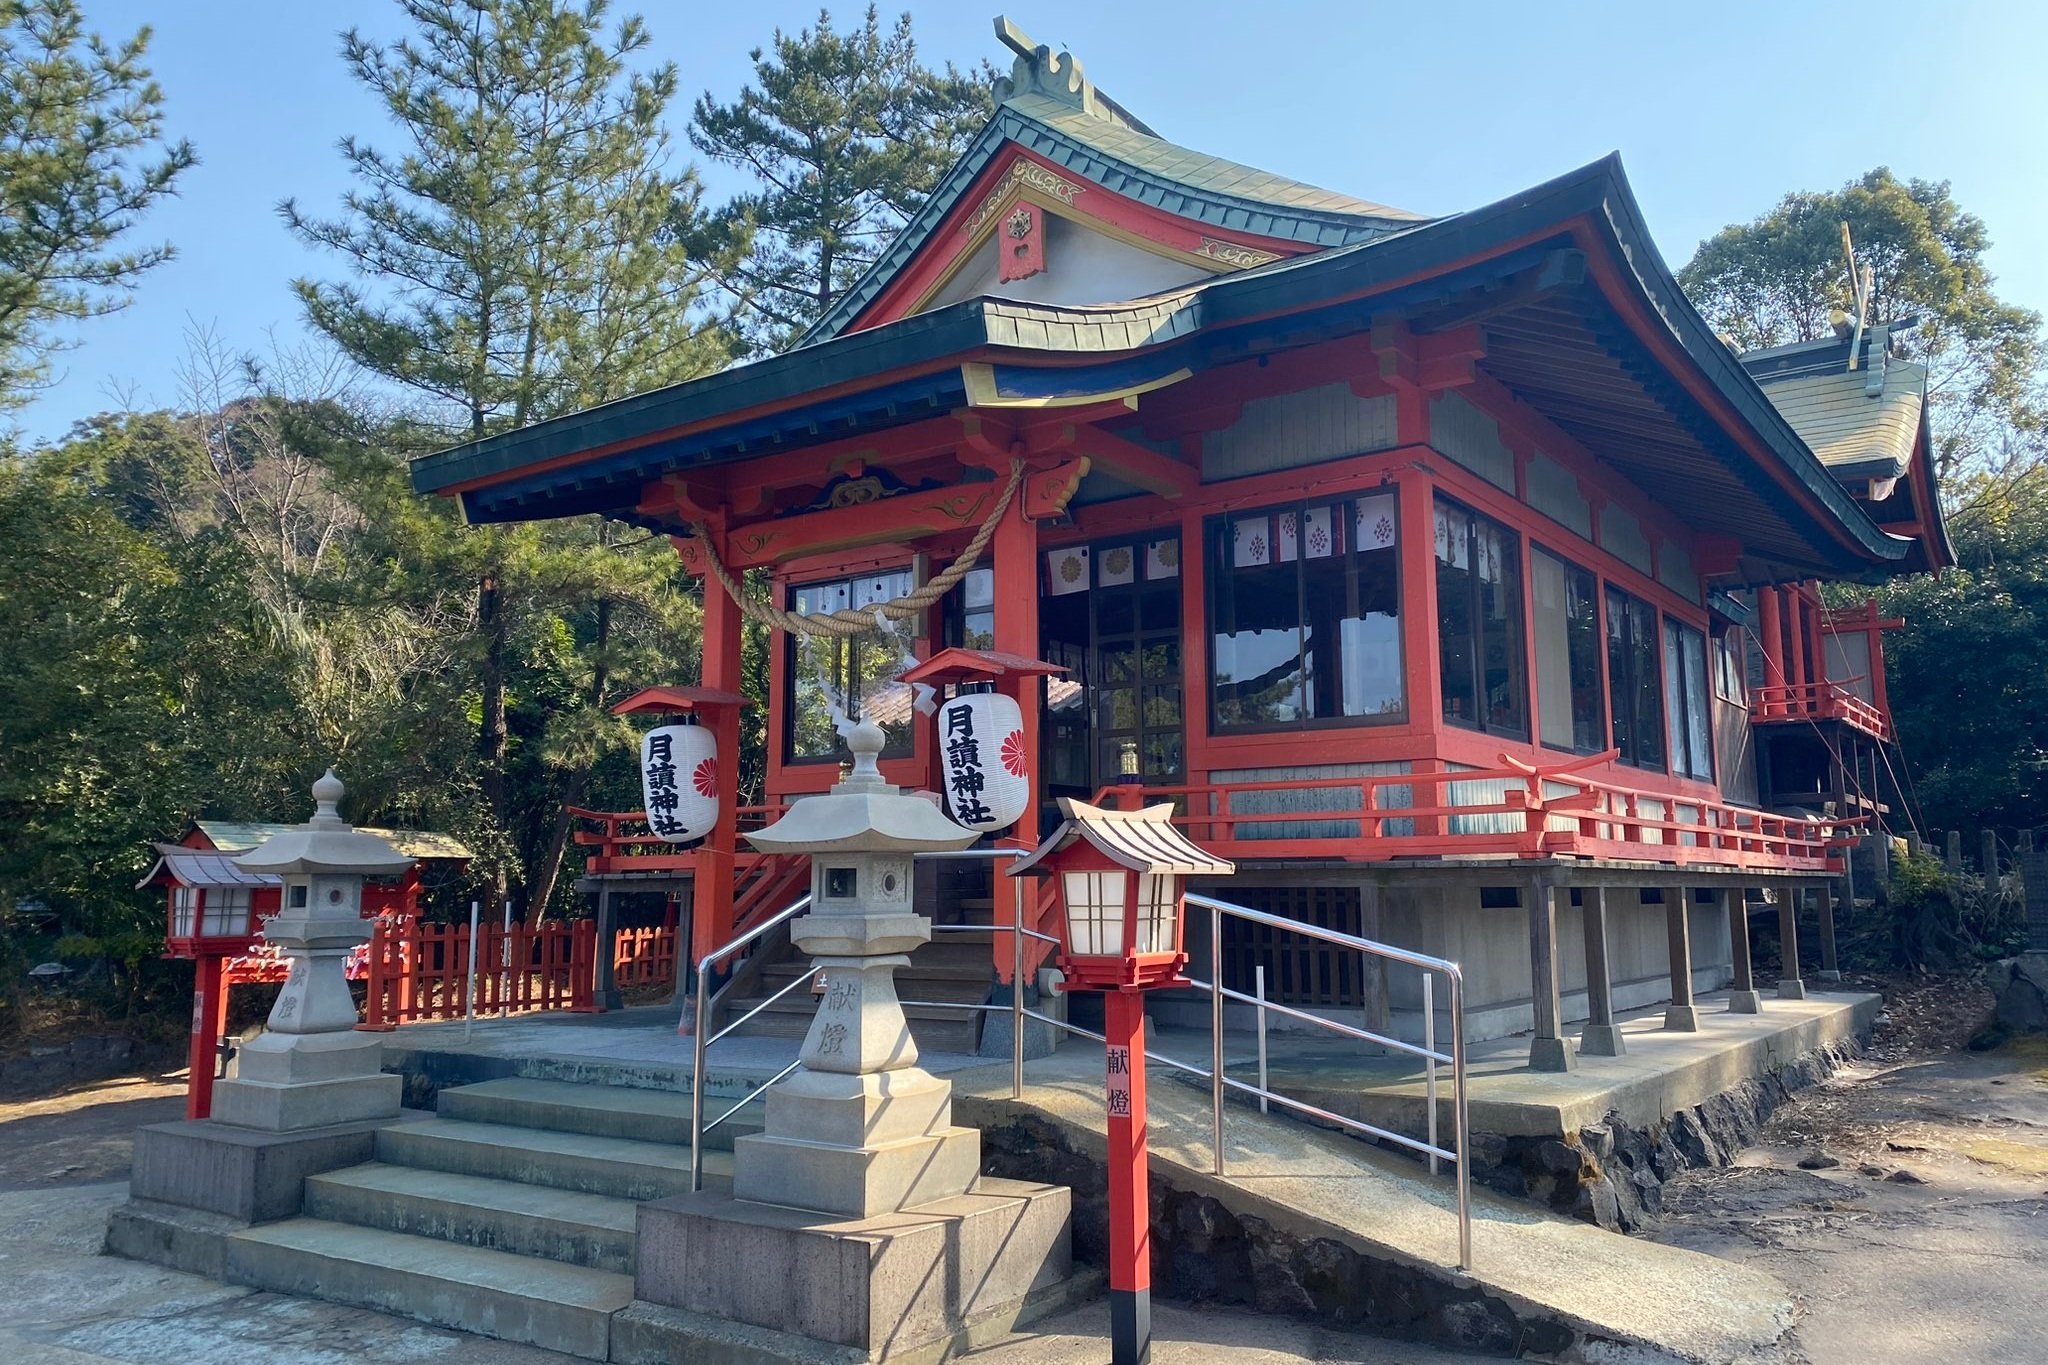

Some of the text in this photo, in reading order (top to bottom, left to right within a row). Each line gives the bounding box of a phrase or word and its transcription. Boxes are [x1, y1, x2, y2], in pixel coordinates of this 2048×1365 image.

[646, 733, 689, 836] 月讀神社
[946, 704, 997, 825] 月讀神社
[817, 981, 857, 1054] 献燈
[1107, 1049, 1129, 1114] 献燈
